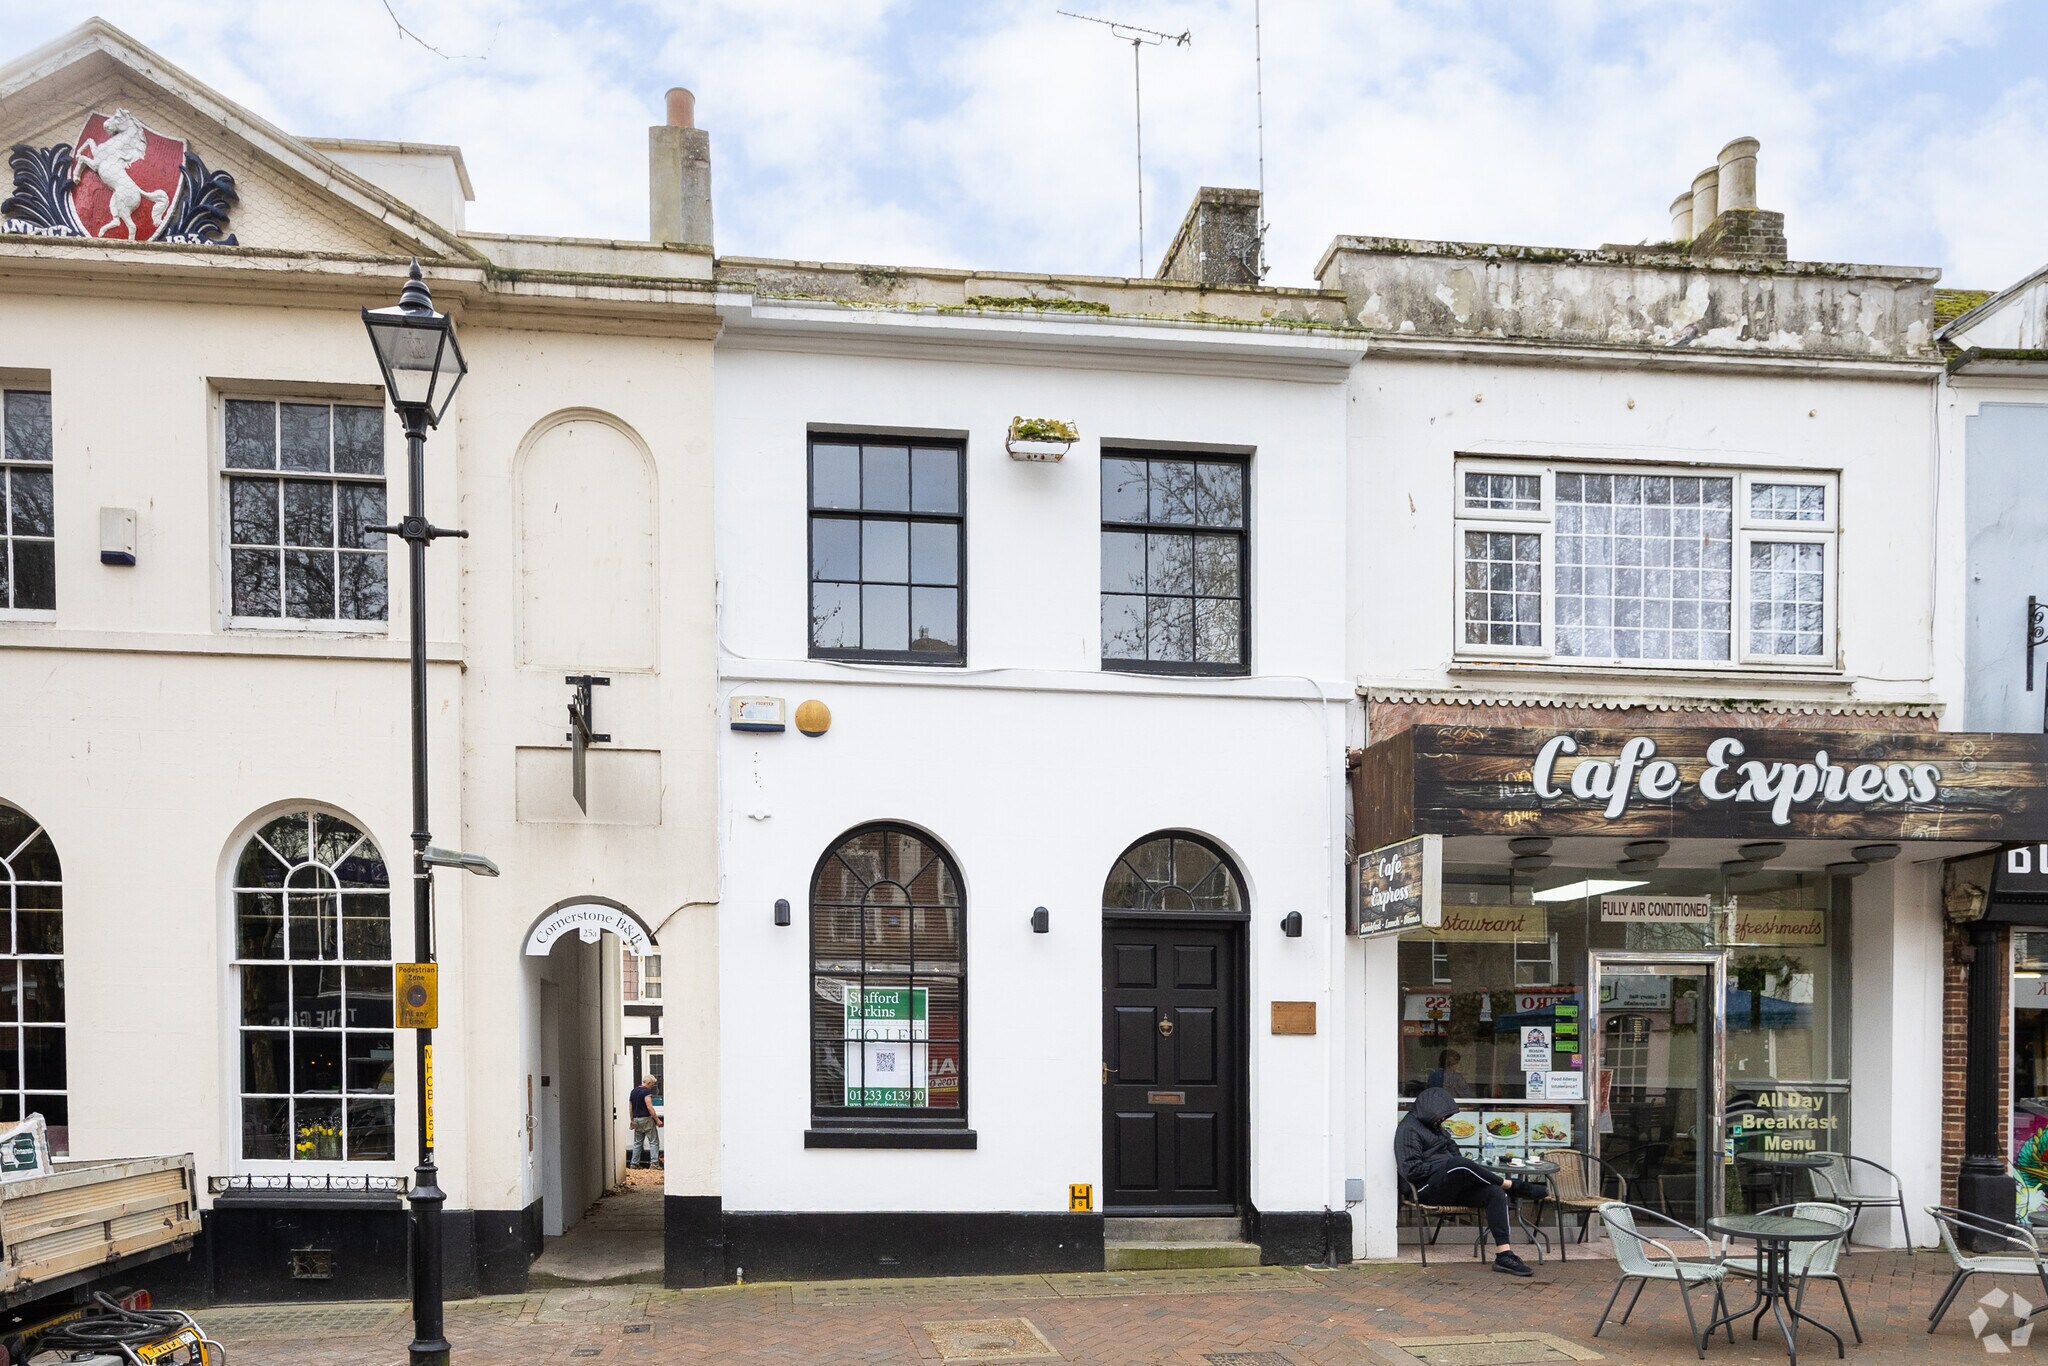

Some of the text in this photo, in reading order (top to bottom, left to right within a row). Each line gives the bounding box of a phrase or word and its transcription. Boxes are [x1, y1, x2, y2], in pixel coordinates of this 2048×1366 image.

[1532, 735, 1942, 827] Cafe Express
[1378, 853, 1402, 882] Cafe
[1370, 885, 1409, 912] Express
[1602, 901, 1708, 917] FULLY AIR CONDITIONED
[536, 911, 642, 946] Cornerstone B&B
[583, 929, 597, 938] 25a
[398, 966, 436, 974] Pedestrian
[849, 991, 900, 1004] Stafford
[415, 1010, 429, 1018] any
[850, 1005, 896, 1018] Perkins
[849, 1090, 882, 1101] 01233
[1757, 1092, 1824, 1112] All Day
[1742, 1114, 1838, 1129] Breakfast
[1764, 1135, 1816, 1151] Menu
[1071, 1185, 1090, 1209] H
